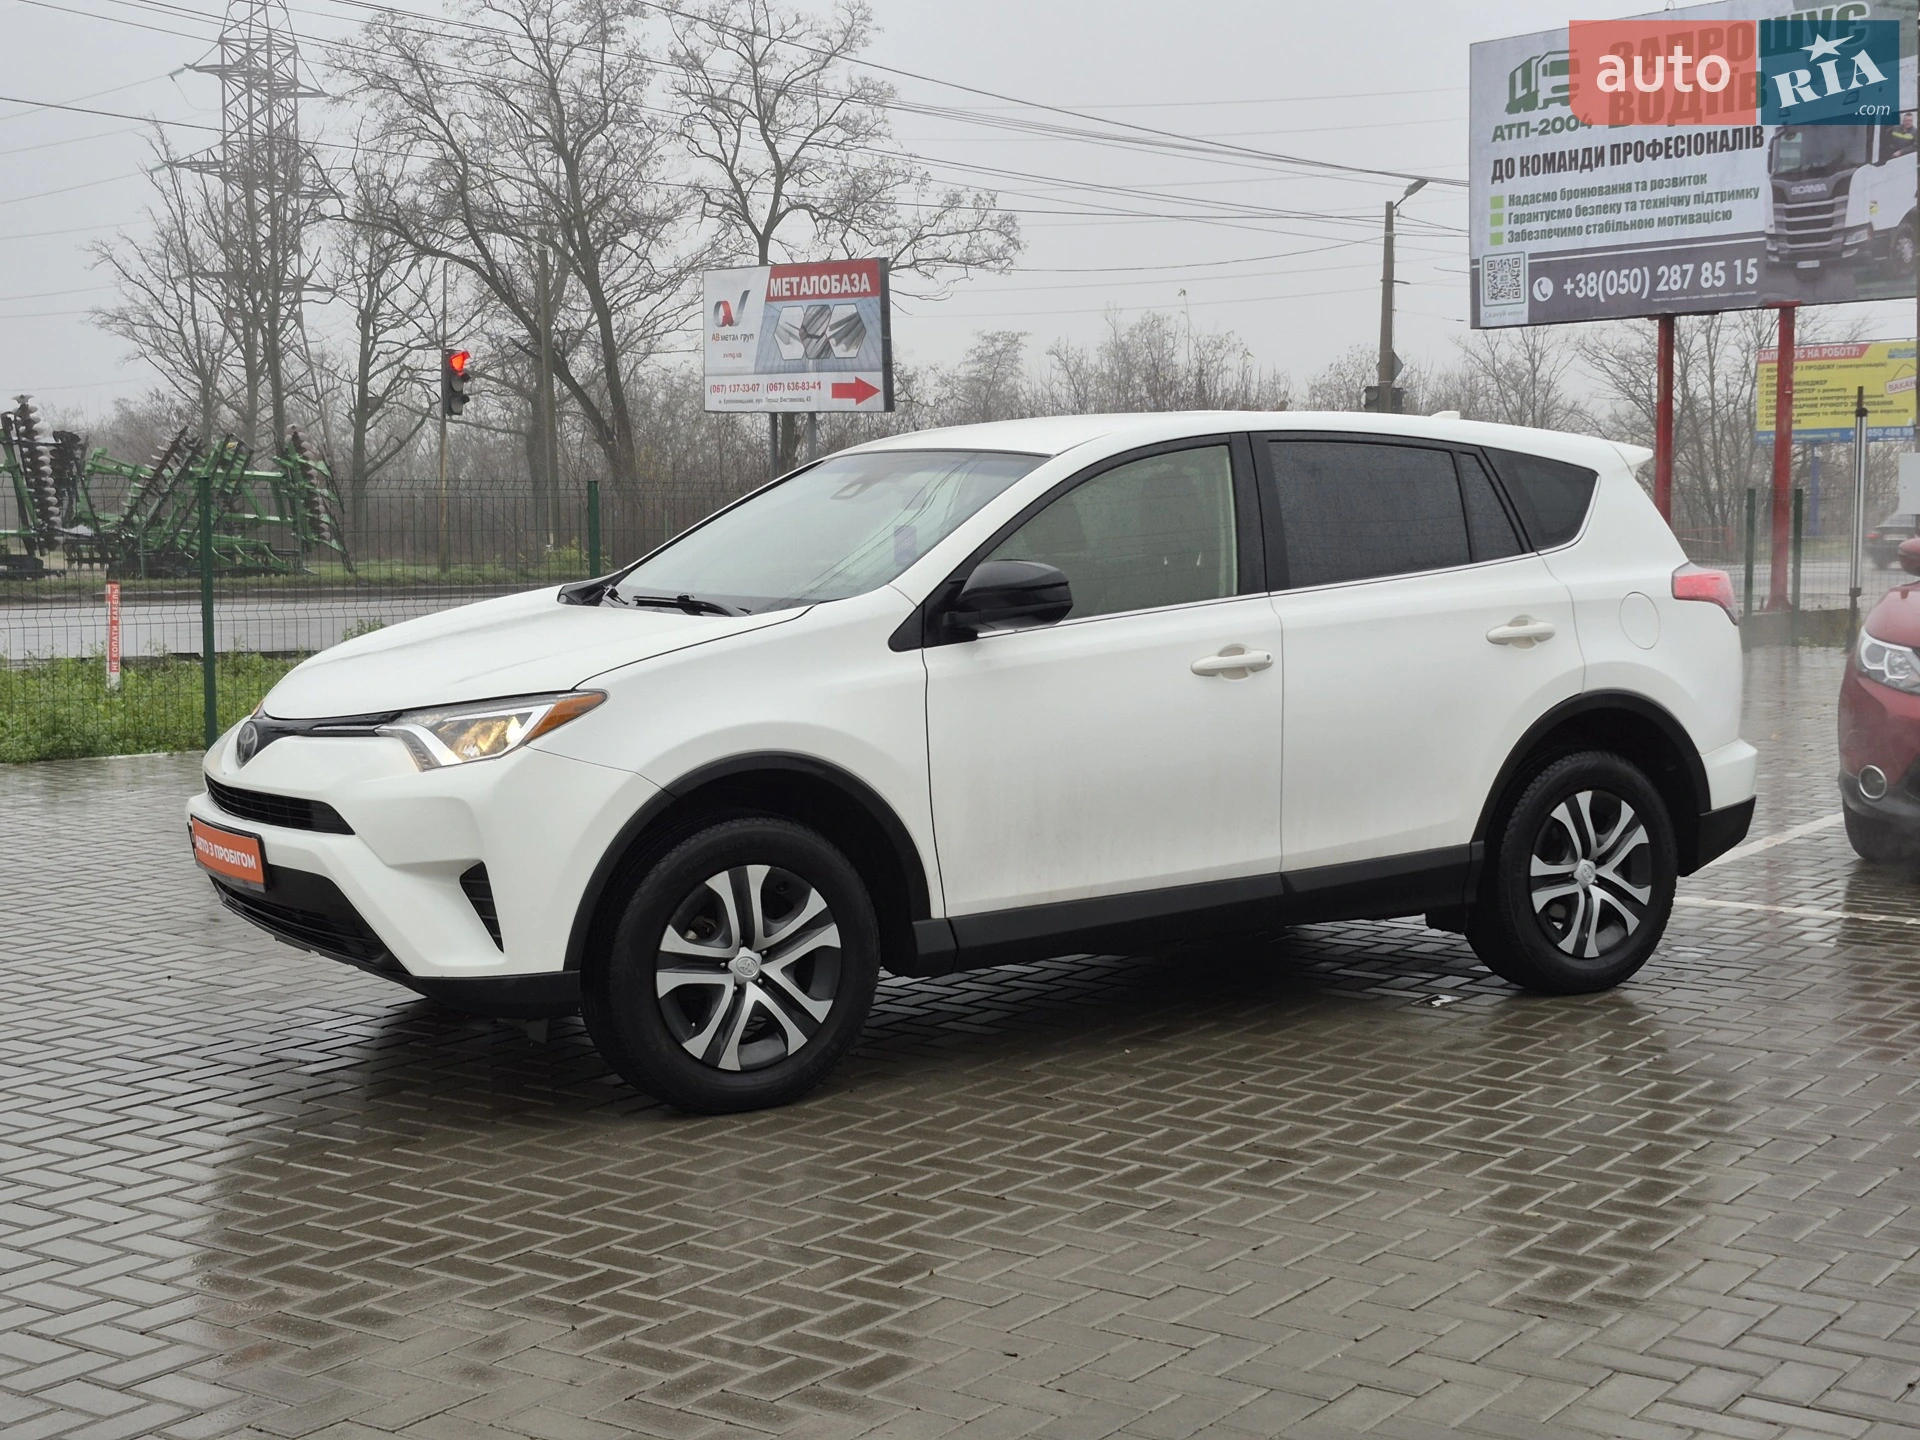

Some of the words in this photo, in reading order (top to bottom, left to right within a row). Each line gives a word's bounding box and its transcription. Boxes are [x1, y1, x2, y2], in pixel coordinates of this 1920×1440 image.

[1491, 157, 1516, 185] ДО
[1519, 145, 1606, 178] КОМАНДИ
[1610, 125, 1765, 167] ПРОФЕСІОНАЛІВ
[1508, 191, 1558, 207] Надаємо
[1560, 182, 1633, 202] бронювання
[1634, 180, 1648, 193] та
[1650, 173, 1708, 192] розвиток
[1790, 182, 1828, 195] SCANIA
[1508, 207, 1573, 225] Гарантуємо
[1574, 201, 1622, 218] безпеку
[1625, 200, 1638, 213] та
[1640, 194, 1692, 211] технічну
[1693, 187, 1761, 205] підтримку
[1507, 223, 1584, 243] Забезпечимо
[1585, 217, 1655, 236] стабільною
[1657, 209, 1733, 229] мотивацією
[769, 272, 872, 298] МЕТАЛОБАЗА
[1563, 266, 1650, 303] +38(050)
[1655, 263, 1695, 292] 287
[1700, 261, 1727, 289] 85
[1733, 258, 1759, 286] 15
[1807, 348, 1820, 358] НА
[111, 659, 119, 671] НЕ
[195, 834, 209, 854] АВТО
[214, 844, 257, 870] ПРОБІГОМ
